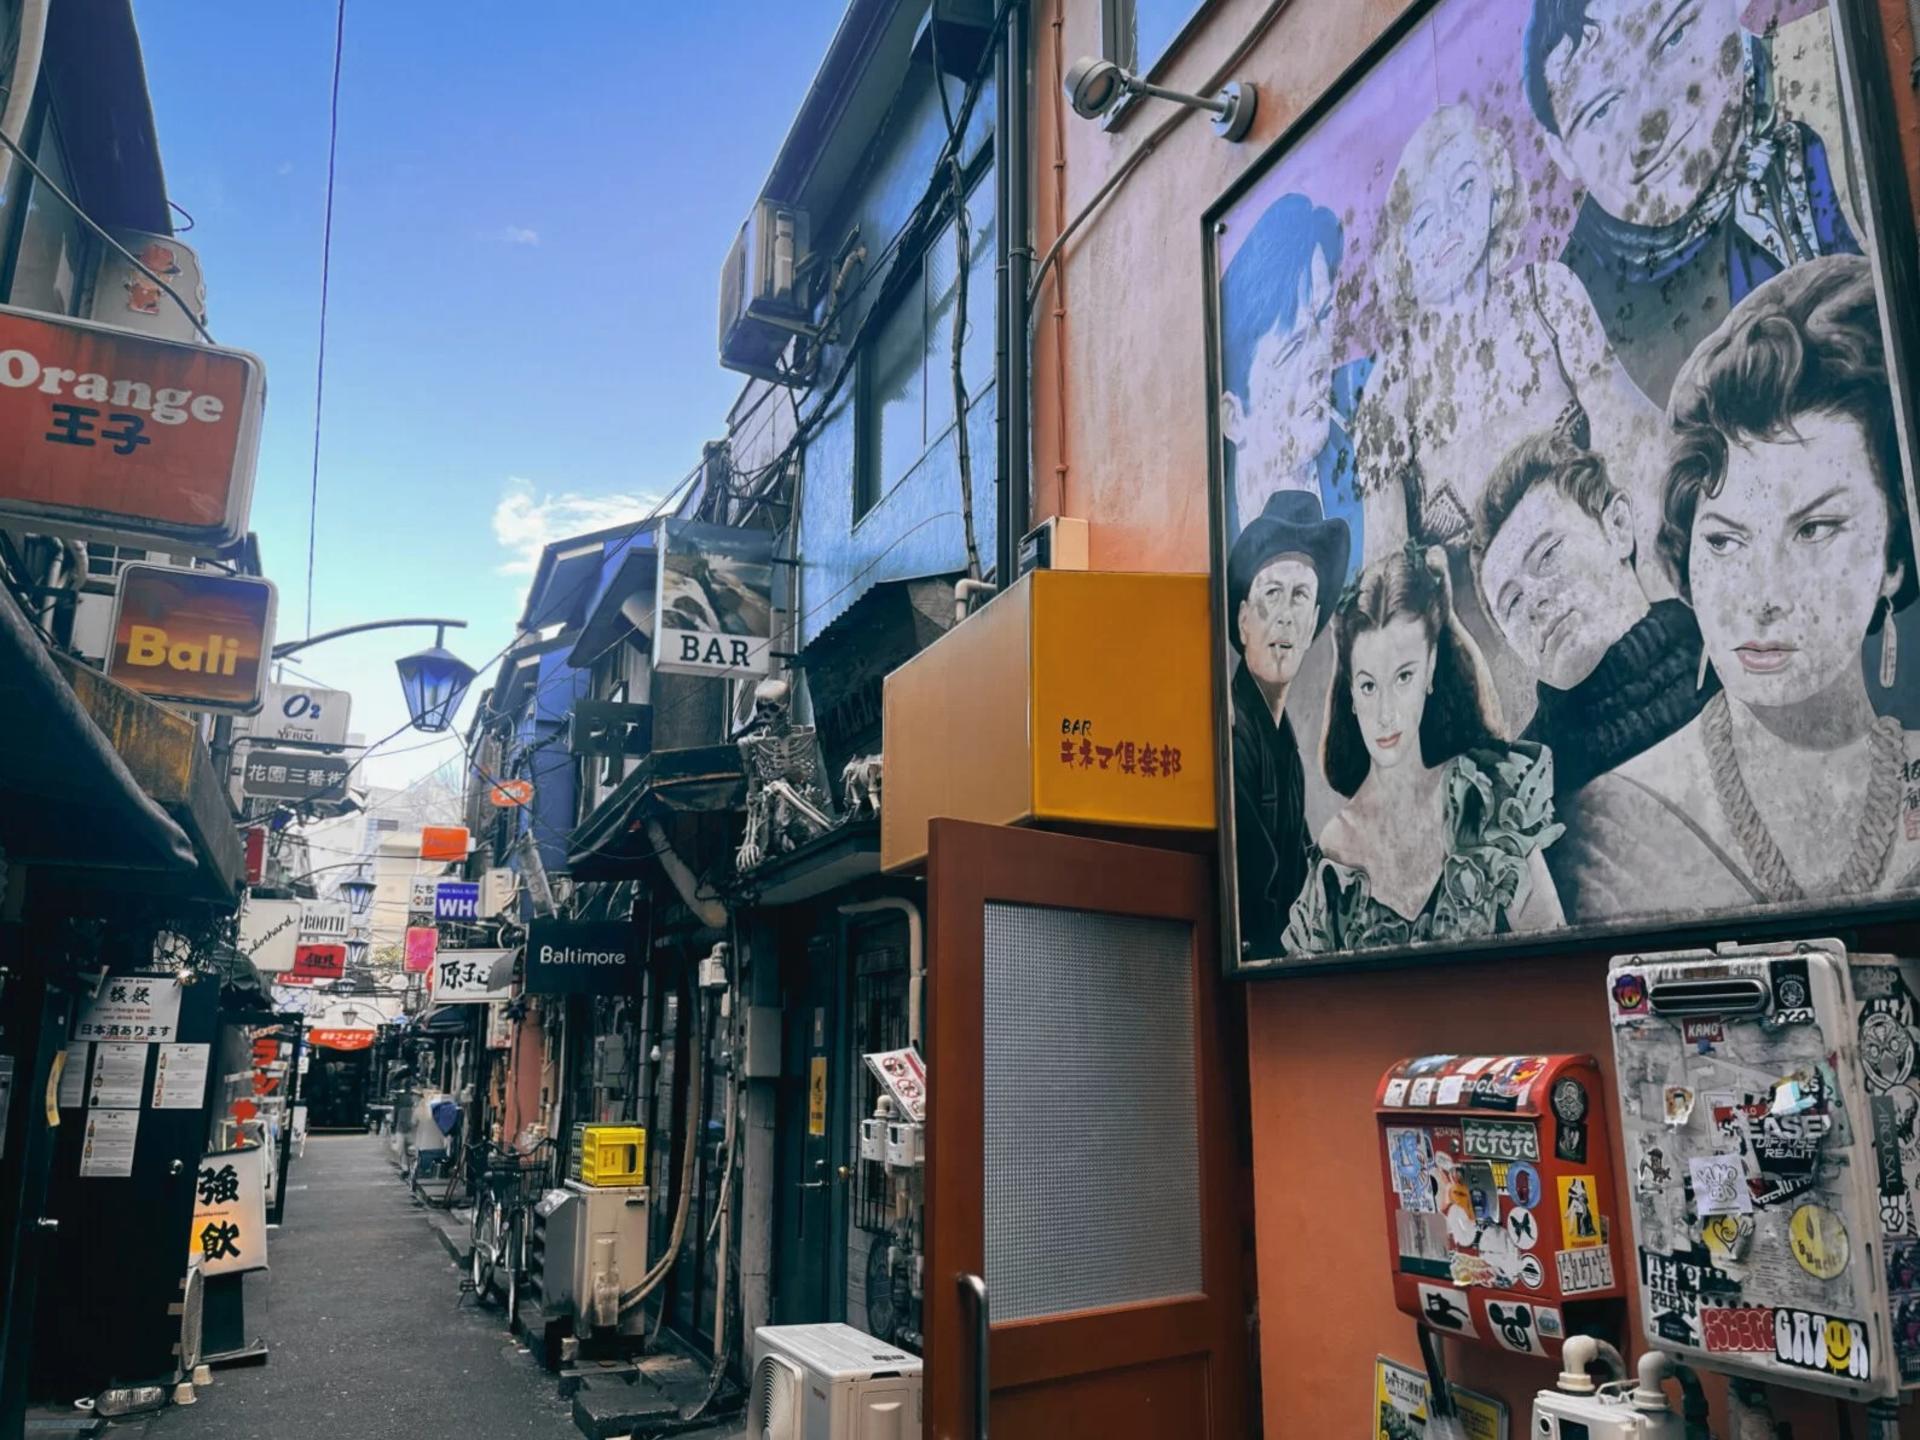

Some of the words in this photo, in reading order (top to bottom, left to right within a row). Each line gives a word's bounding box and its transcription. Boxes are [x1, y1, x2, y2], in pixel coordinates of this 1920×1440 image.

[0, 349, 224, 425] Orange
[45, 403, 151, 455] 王子
[126, 625, 240, 675] Bali
[680, 634, 750, 667] BAR
[1060, 718, 1092, 736] BAR
[303, 914, 345, 934] BOOTH
[539, 945, 626, 966] Baltimore
[80, 1024, 171, 1037] 日本酒あります
